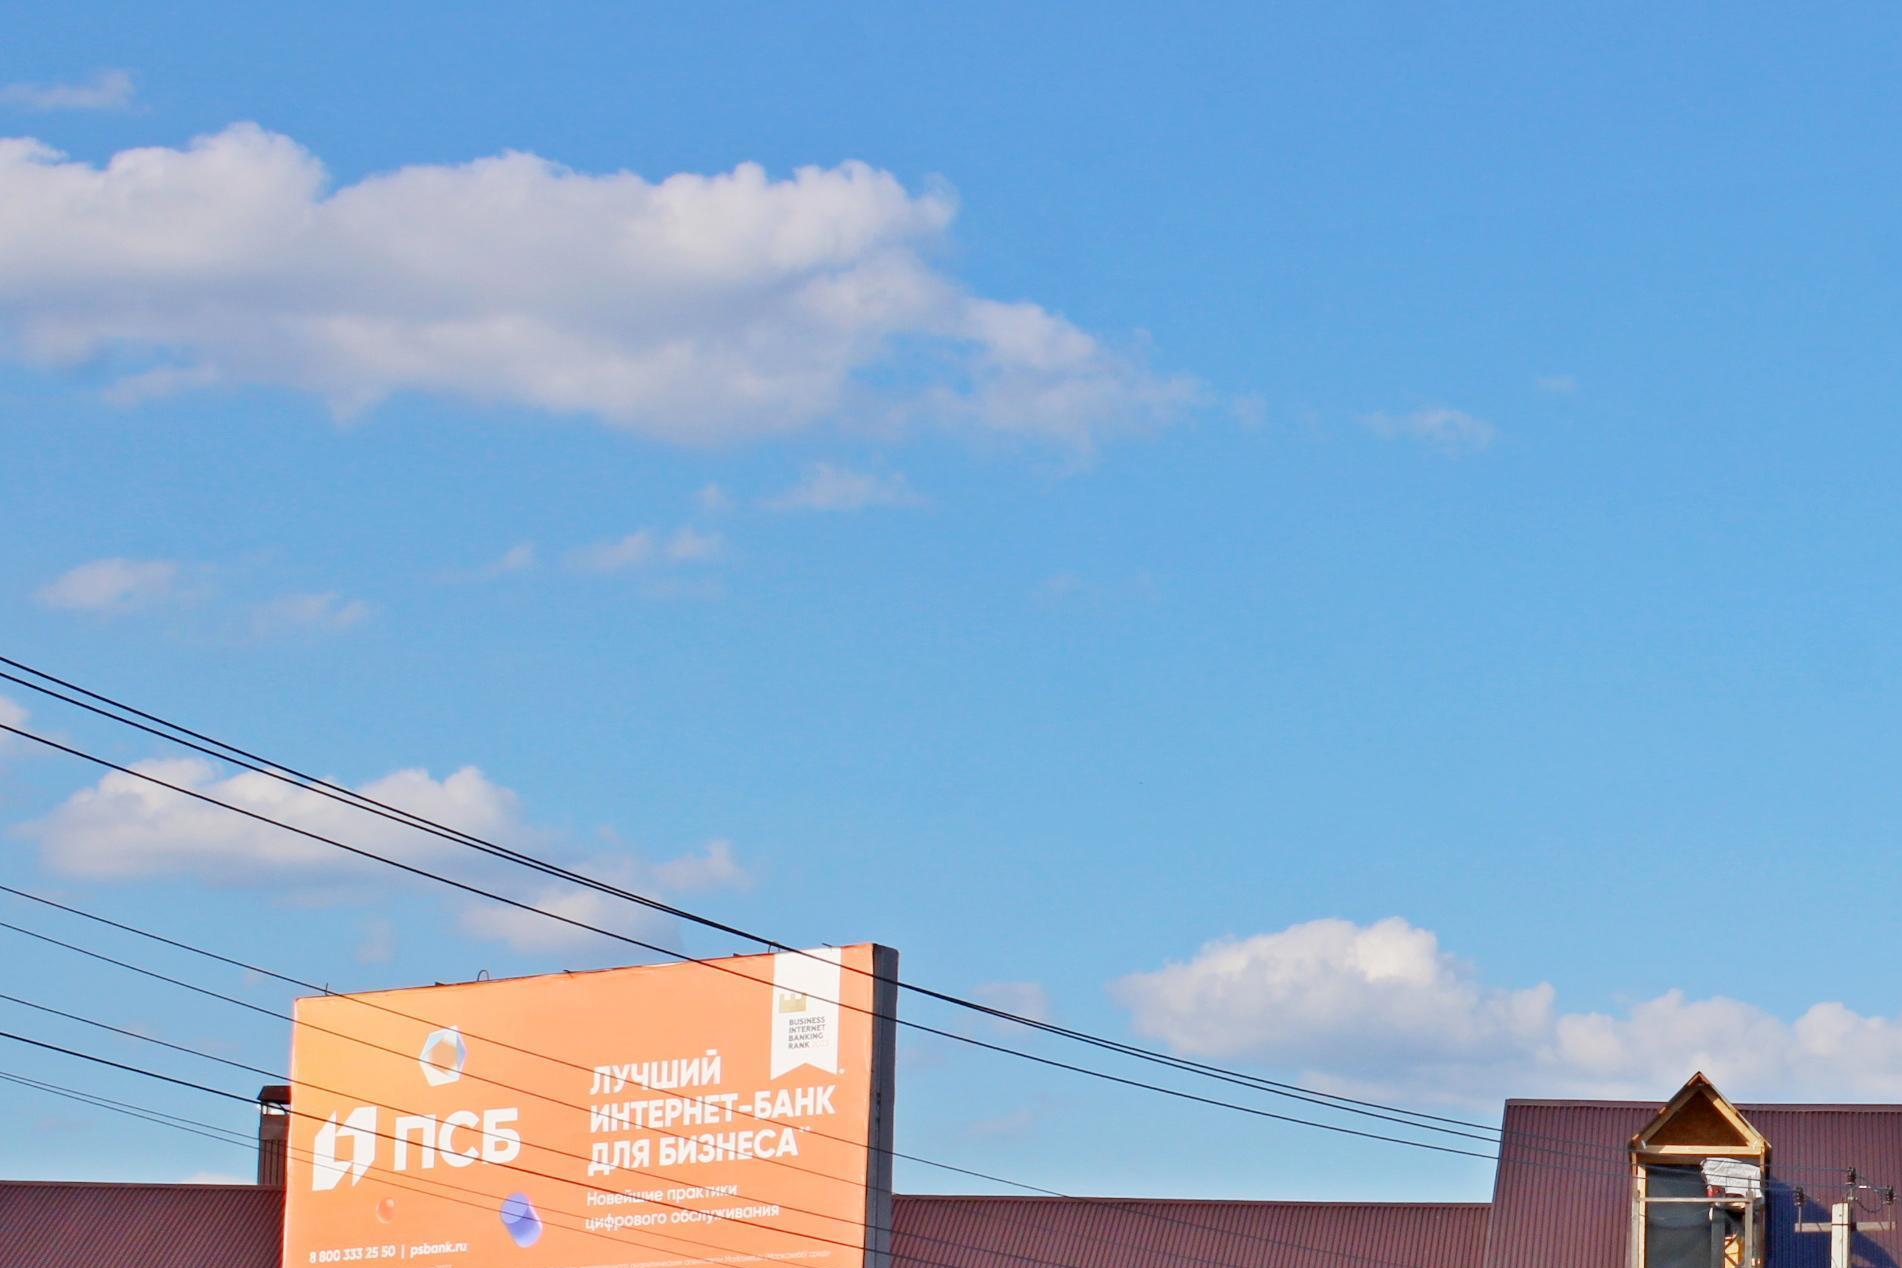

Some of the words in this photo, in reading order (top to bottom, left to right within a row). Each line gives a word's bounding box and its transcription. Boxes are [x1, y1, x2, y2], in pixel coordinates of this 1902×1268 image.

[788, 1016, 825, 1026] BUSINESS
[788, 1024, 825, 1034] INTERNET
[788, 1032, 823, 1042] BANKING
[788, 1041, 810, 1049] RANK
[590, 1049, 721, 1095] ЛУЧШИЙ
[590, 1085, 836, 1133] ИНТЕРНЕТ-БАНК
[393, 1107, 521, 1171] ПСБ
[587, 1139, 650, 1176] ДЛЯ
[587, 1188, 663, 1207] Новейшие
[667, 1184, 738, 1203] практики
[585, 1209, 667, 1233] цифрового
[671, 1203, 780, 1224] обслуживания
[309, 1251, 317, 1264] 8
[319, 1249, 340, 1263] 800
[343, 1248, 363, 1261] 333
[365, 1246, 379, 1259] 25
[381, 1245, 396, 1258] 50
[410, 1241, 468, 1258] psbank.ru
